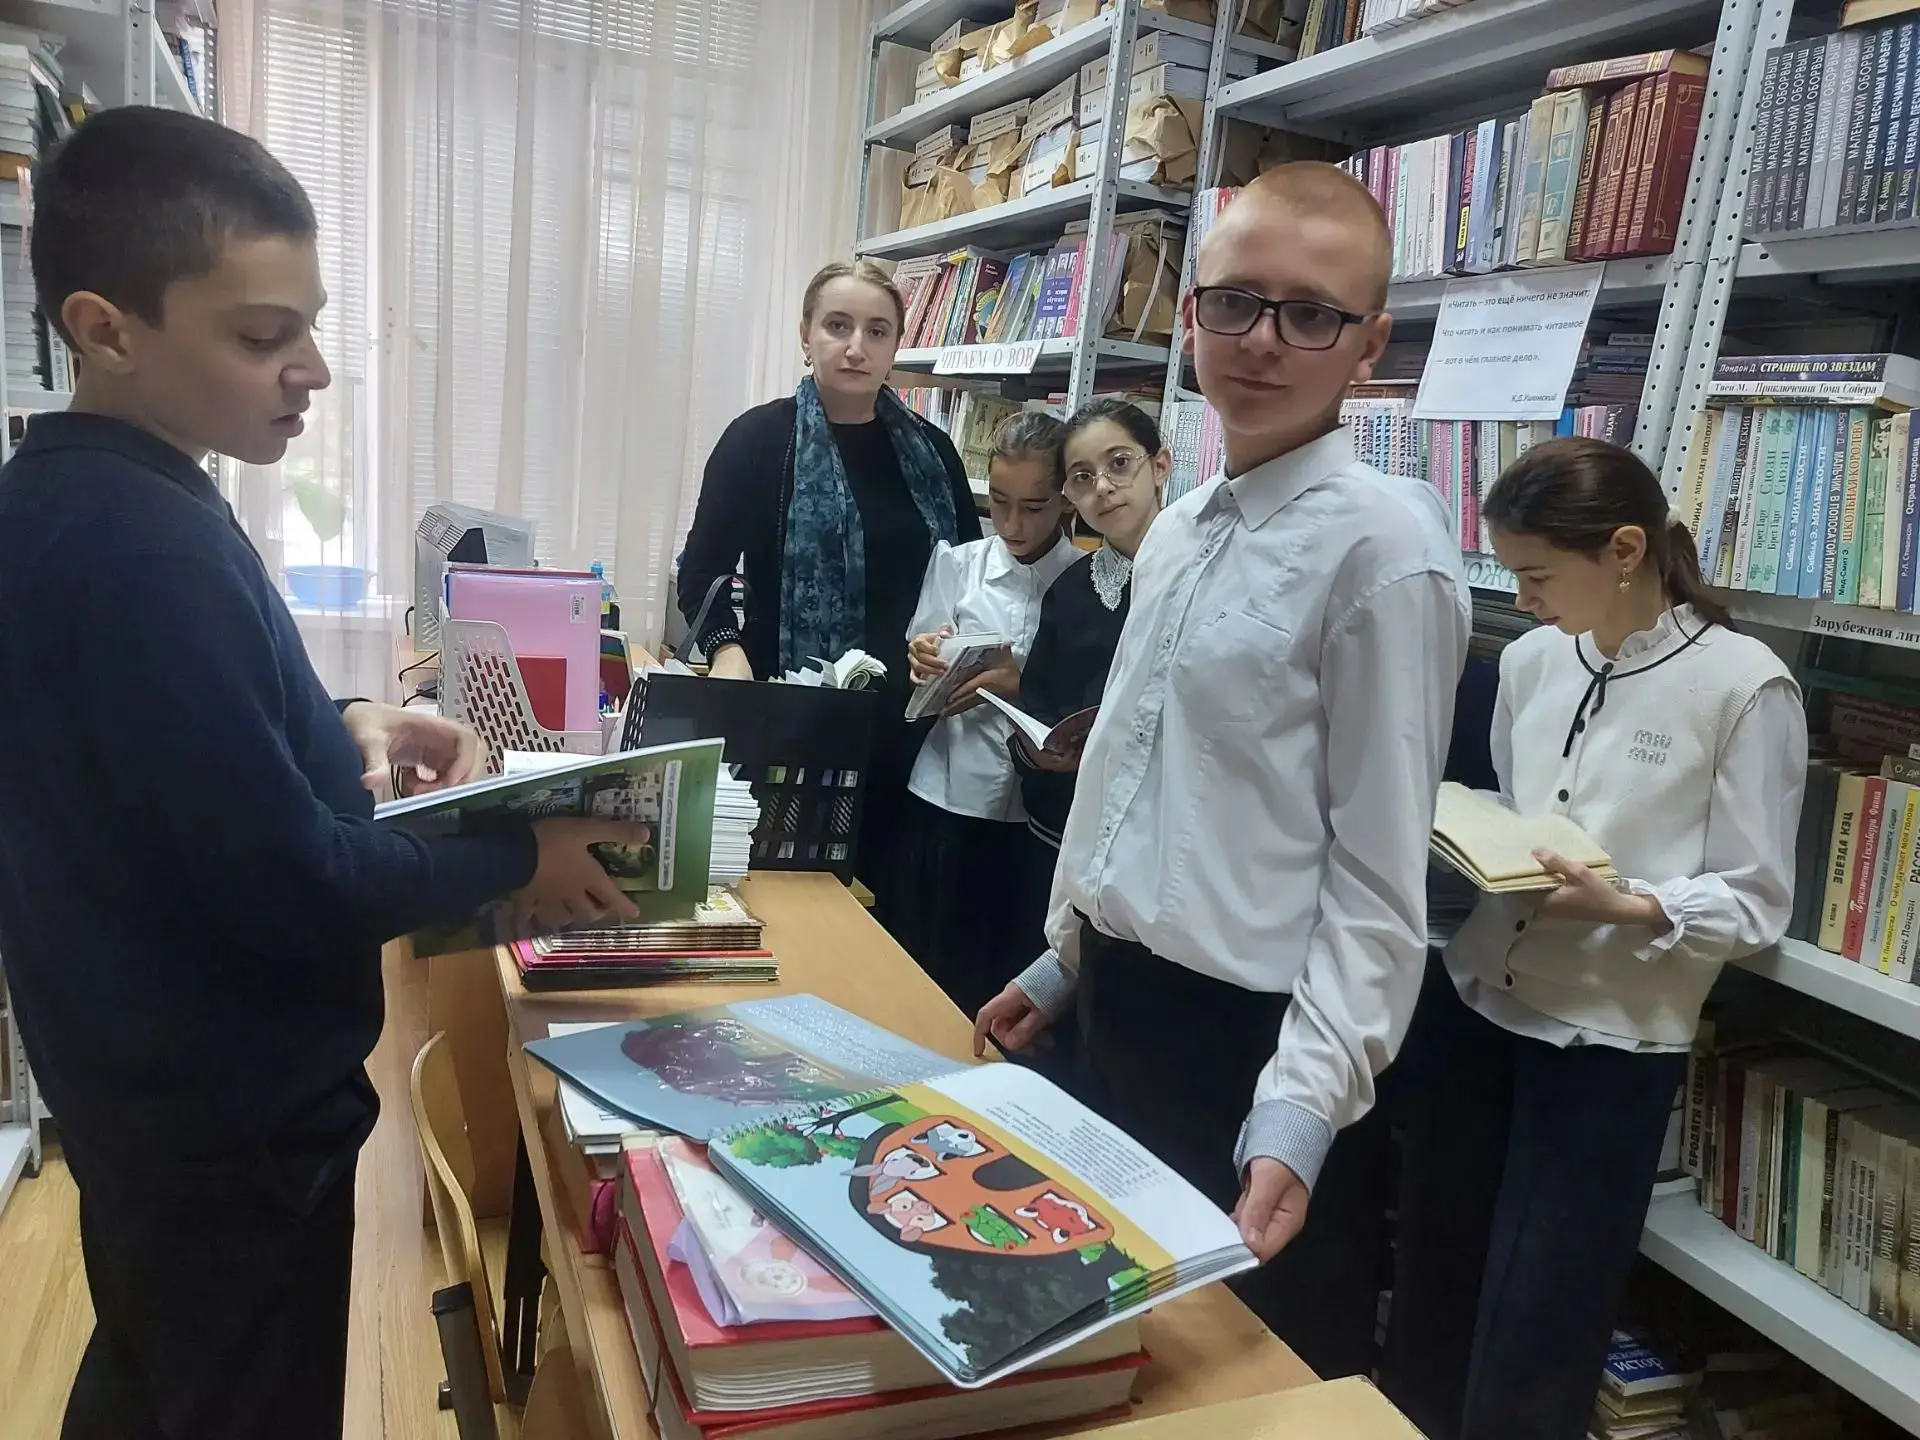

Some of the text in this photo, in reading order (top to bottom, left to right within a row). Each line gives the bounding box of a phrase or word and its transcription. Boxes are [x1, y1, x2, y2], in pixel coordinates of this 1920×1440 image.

[1857, 35, 1877, 91] ОБОРВЫШ
[1877, 29, 1894, 76] КАРЬЕРОВ
[1897, 23, 1913, 72] КАРЬЕРОВ
[1761, 56, 1779, 108] ОБОРВЫШ
[1870, 76, 1886, 125] ПЕСЧАНЫХ
[1890, 71, 1906, 121] ПЕСЧАНЫХ
[1766, 107, 1785, 170] МАЛЕНЬКИЙ
[1776, 52, 1794, 105] ОБОРВЫШ
[1781, 104, 1801, 169] МАЛЕНЬКИЙ
[1791, 48, 1809, 102] ОБОРВЫШ
[1797, 102, 1817, 167] МАЛЕНЬКИЙ
[1807, 45, 1825, 100] ОБОРВЫШ
[1848, 94, 1868, 159] МАЛЕНЬКИЙ
[1752, 109, 1772, 173] МАЛЕНЬКИЙ
[1864, 126, 1879, 170] ГЕНЕРАЛЫ
[1884, 122, 1900, 167] ГЕНЕРАЛЫ
[1484, 298, 1496, 306] это
[1498, 294, 1515, 306] ещё
[1516, 293, 1545, 303] ничего
[1547, 291, 1558, 300] не
[1442, 328, 1454, 337] Что
[1455, 328, 1479, 336] читать
[1487, 326, 1501, 334] как
[1502, 323, 1543, 333] понимать
[1544, 320, 1584, 330] читаемое
[941, 347, 1035, 369] ЧИТАЕМ О ВОВ
[1445, 357, 1457, 365] вот
[1480, 355, 1511, 363] главное
[1719, 364, 1748, 374] Лондон
[1760, 361, 1811, 374] СТРАННИК
[1812, 361, 1828, 372] ПО
[1829, 361, 1876, 372] ЗВЕЗДАМ
[1715, 382, 1877, 396] Твен М. Приключения Тома Сойера
[1736, 415, 1751, 463] ДАТСКИЙ
[1837, 412, 1848, 435] Бойн
[1695, 459, 1707, 497] МИХАИЛ
[1701, 414, 1714, 458] ШОЛОХОВ
[1849, 419, 1864, 477] КОРОЛЕВА
[1909, 438, 1920, 482] сокровищ
[1830, 451, 1844, 492] МАЛЬЧИК
[1757, 509, 1768, 527] Гарт
[1771, 510, 1781, 528] Гарт
[1785, 538, 1797, 570] Сиболд
[1791, 486, 1803, 524] МИЛЫЕ
[1797, 445, 1807, 486] КОСТИ
[1806, 540, 1817, 574] Сиболд
[1812, 487, 1822, 526] МИЛЫЕ
[1817, 446, 1827, 487] КОСТИ
[1842, 479, 1858, 542] ШКОЛЬНАЯ
[1905, 484, 1917, 515] Остров
[1754, 528, 1764, 549] Брет
[1768, 529, 1778, 550] Брет
[1826, 503, 1840, 556] ПОЛОСАТОЙ
[1902, 523, 1912, 561] Стивенсон
[1734, 572, 1742, 582] 2
[1823, 557, 1835, 594] ПИЖАМЕ
[1838, 556, 1848, 596] Мид-Смит
[1814, 614, 1893, 639] Зарубежная
[1869, 791, 1882, 815] Финна
[1904, 802, 1914, 829] голова
[1833, 839, 1849, 885] ЗВЕЗДА
[1841, 811, 1854, 836] КЭЦ
[1864, 816, 1879, 860] Гекльберри
[1901, 829, 1909, 848] моя
[1850, 860, 1870, 913] Приключения
[1895, 849, 1908, 882] думает
[1883, 915, 1895, 954] Пивоварова
[1896, 900, 1915, 965] Джек Лондон
[1688, 1109, 1703, 1168] БРОДЯГИ
